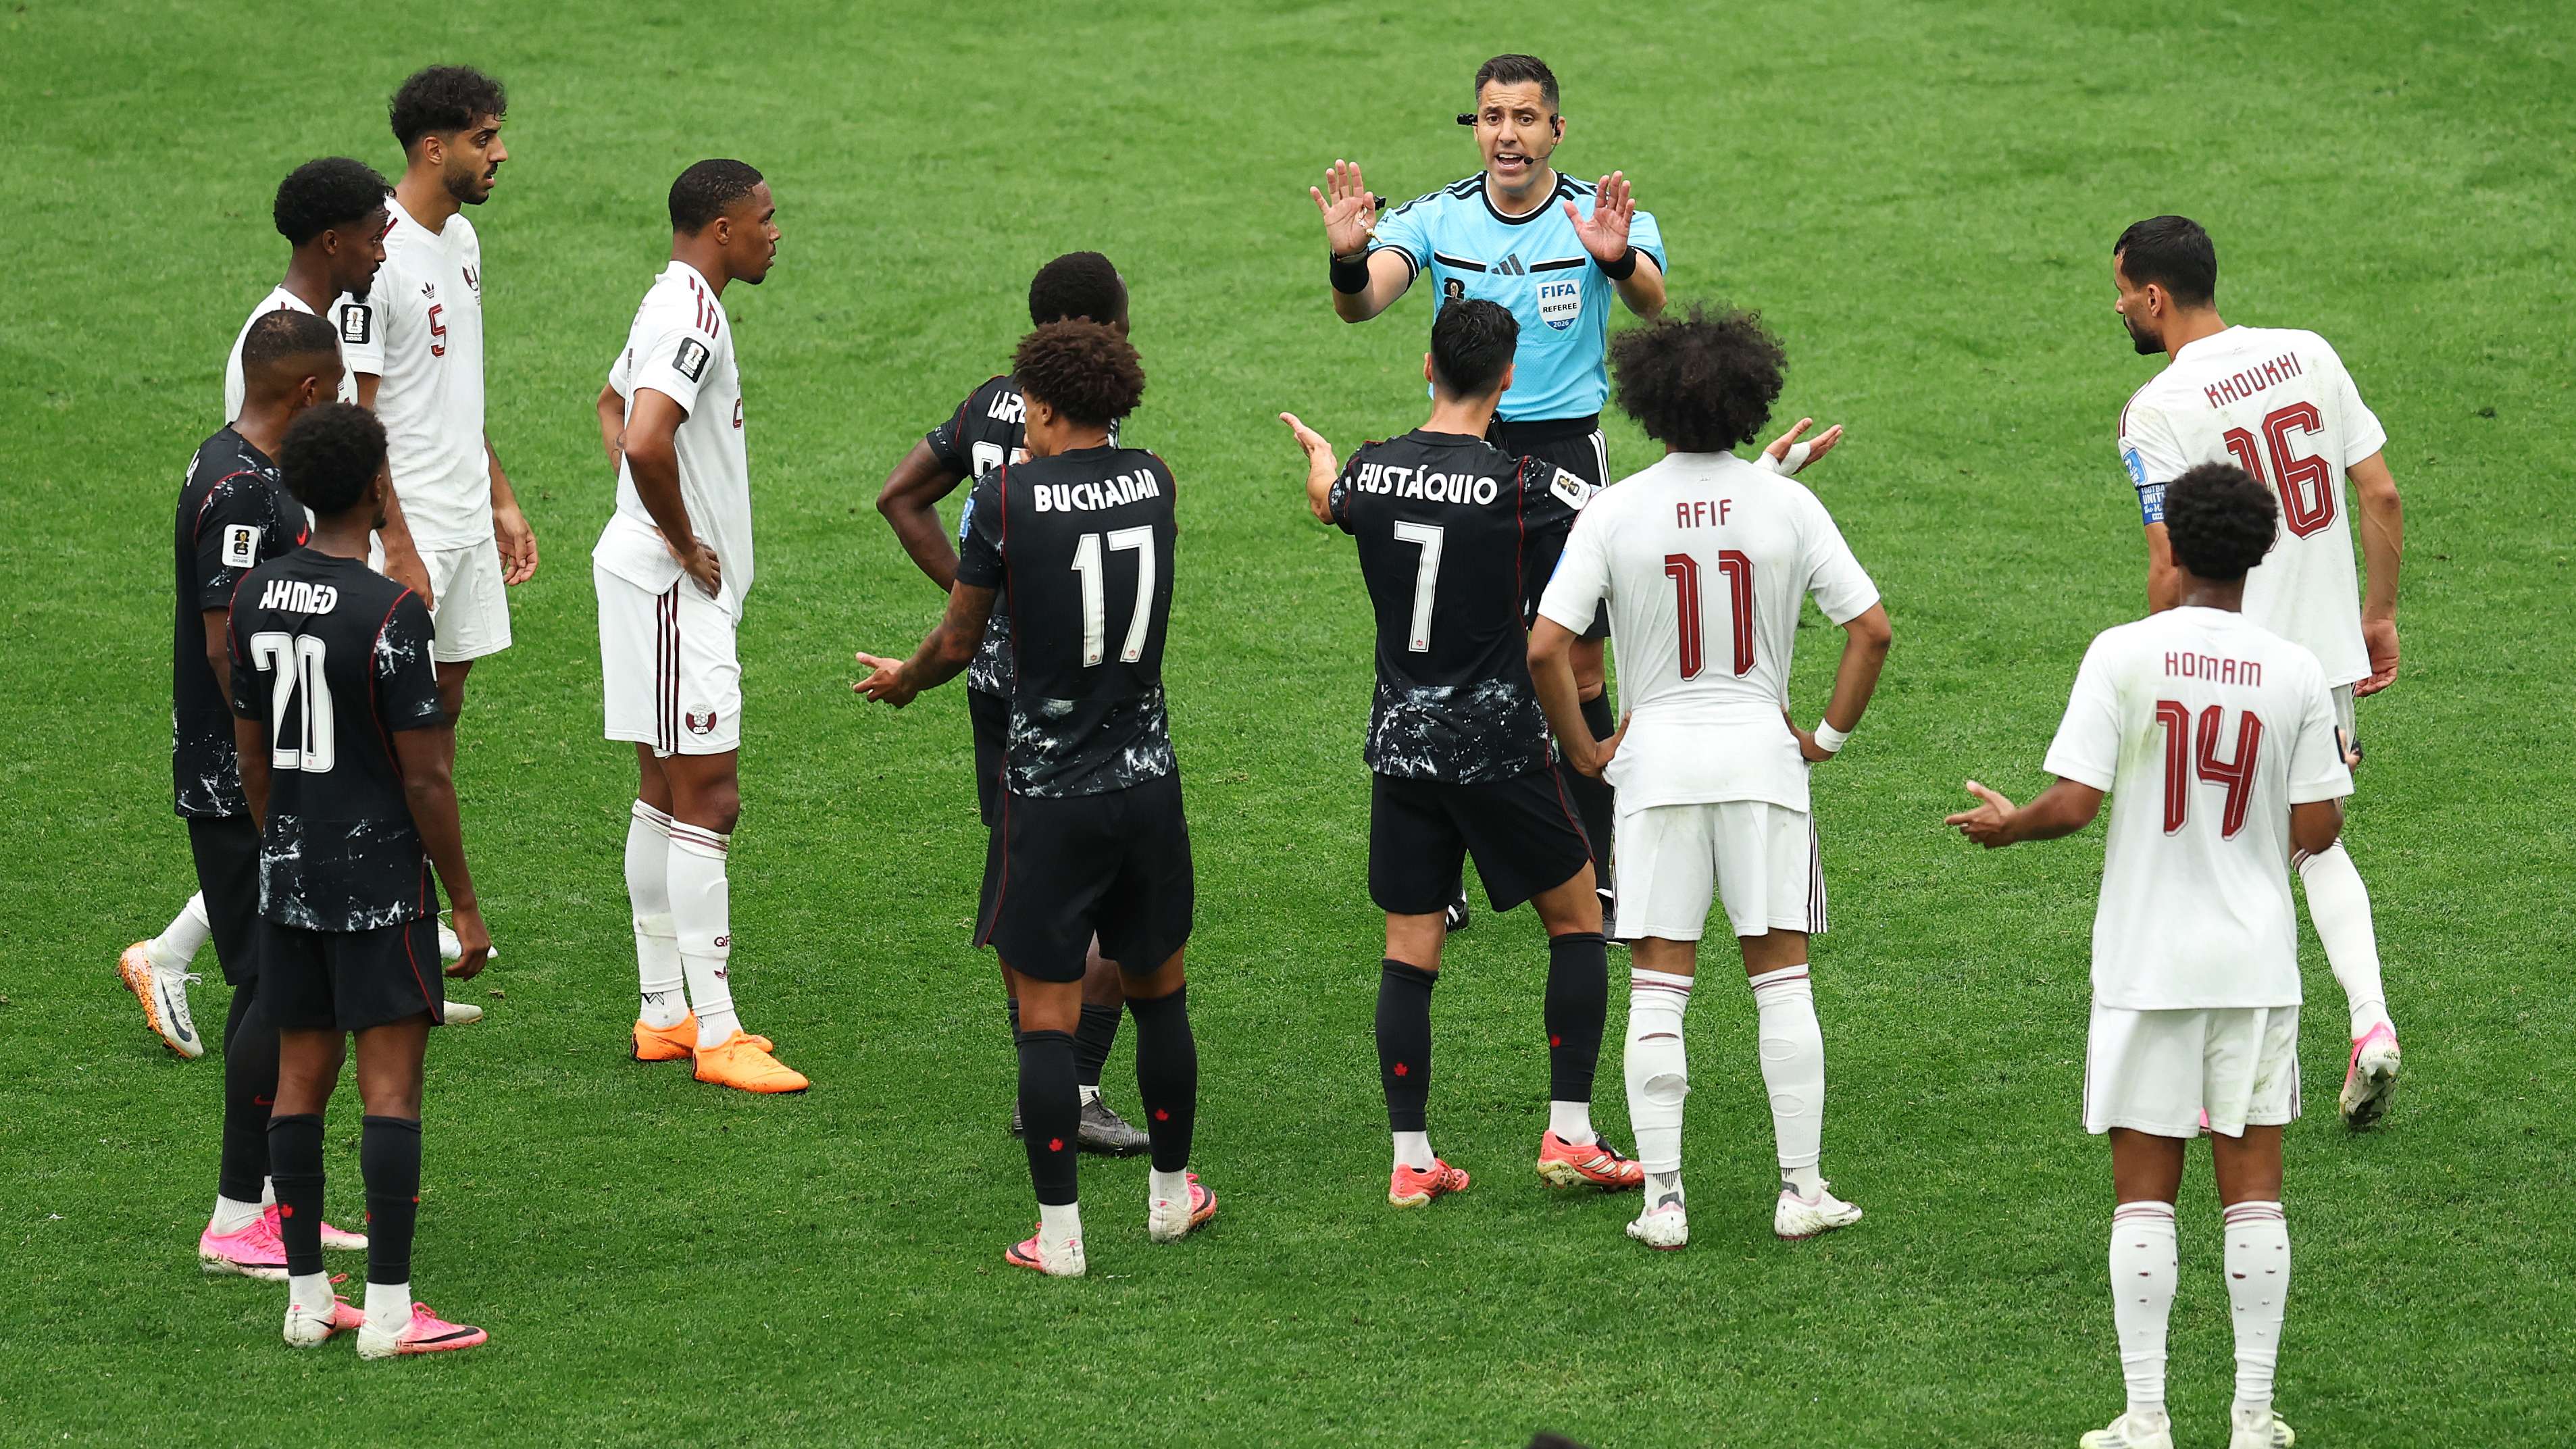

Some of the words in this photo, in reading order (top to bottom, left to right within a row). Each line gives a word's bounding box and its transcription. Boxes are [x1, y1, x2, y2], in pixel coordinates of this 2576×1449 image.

[1542, 283, 1576, 299] FIFA
[1543, 303, 1577, 313] REFEREE
[428, 303, 447, 359] 5
[1552, 320, 1569, 328] 2026
[2204, 351, 2303, 409] KHOUKHI
[1034, 468, 1160, 513] BUCHANAN
[1357, 463, 1498, 505] EUSTÁQUIO
[2142, 492, 2165, 505] UNIT
[2223, 401, 2339, 553] 16
[1677, 499, 1732, 529] AFIF
[258, 580, 338, 615] AHMED
[1071, 524, 1156, 668] 17
[1394, 520, 1444, 653] 7
[1665, 549, 1758, 682] 11
[2165, 651, 2262, 688] HOMAM
[250, 631, 336, 773] 20
[2156, 700, 2265, 842] 14
